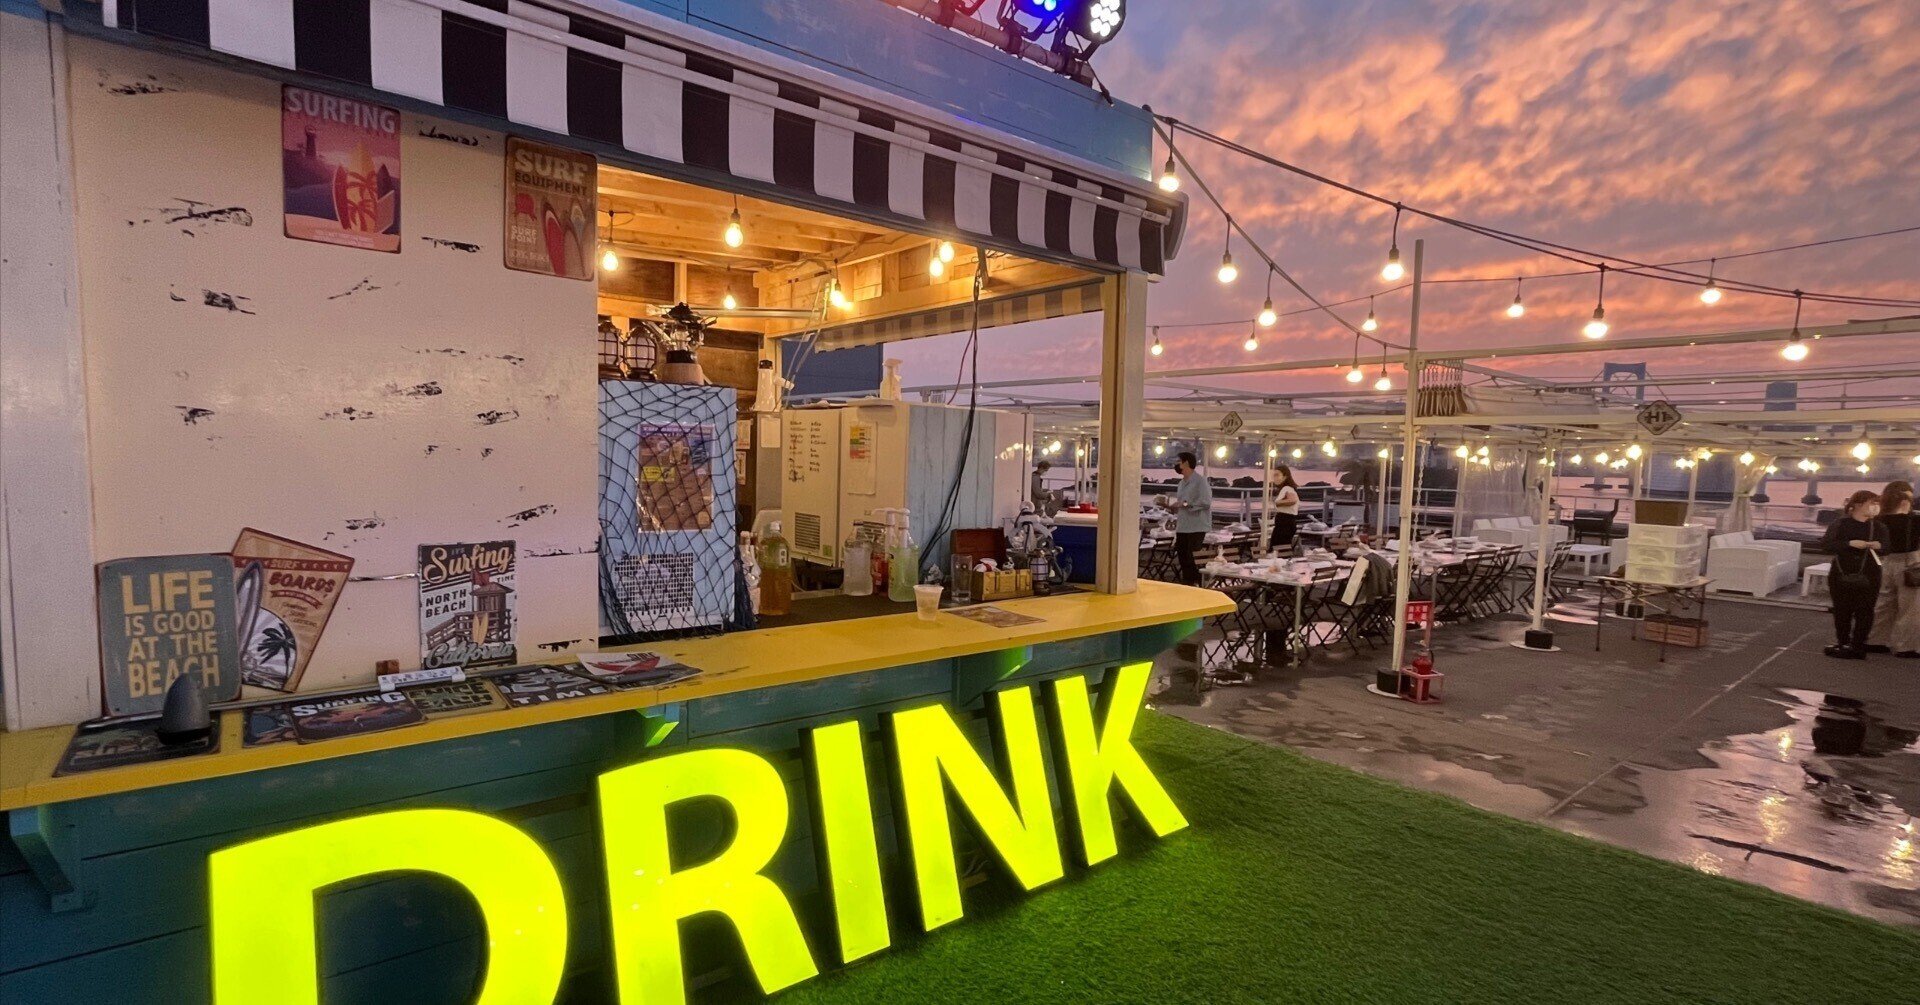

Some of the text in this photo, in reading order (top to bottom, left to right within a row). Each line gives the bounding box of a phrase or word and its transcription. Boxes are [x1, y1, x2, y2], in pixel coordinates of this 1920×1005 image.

[287, 88, 396, 134] SURFING
[515, 148, 588, 184] SURF
[515, 171, 588, 197] EQUIPMENT
[423, 544, 513, 584] Surfing
[122, 569, 216, 615] LIFE
[269, 571, 336, 593] BOARDS
[425, 588, 468, 607] NORTH
[425, 600, 467, 618] BEACH
[124, 609, 216, 637] IS GOOD
[127, 630, 218, 662] AT THE
[425, 639, 515, 669] California
[291, 691, 407, 717] SURFING
[512, 686, 608, 704] TIME
[210, 661, 1188, 1005] DRINK
